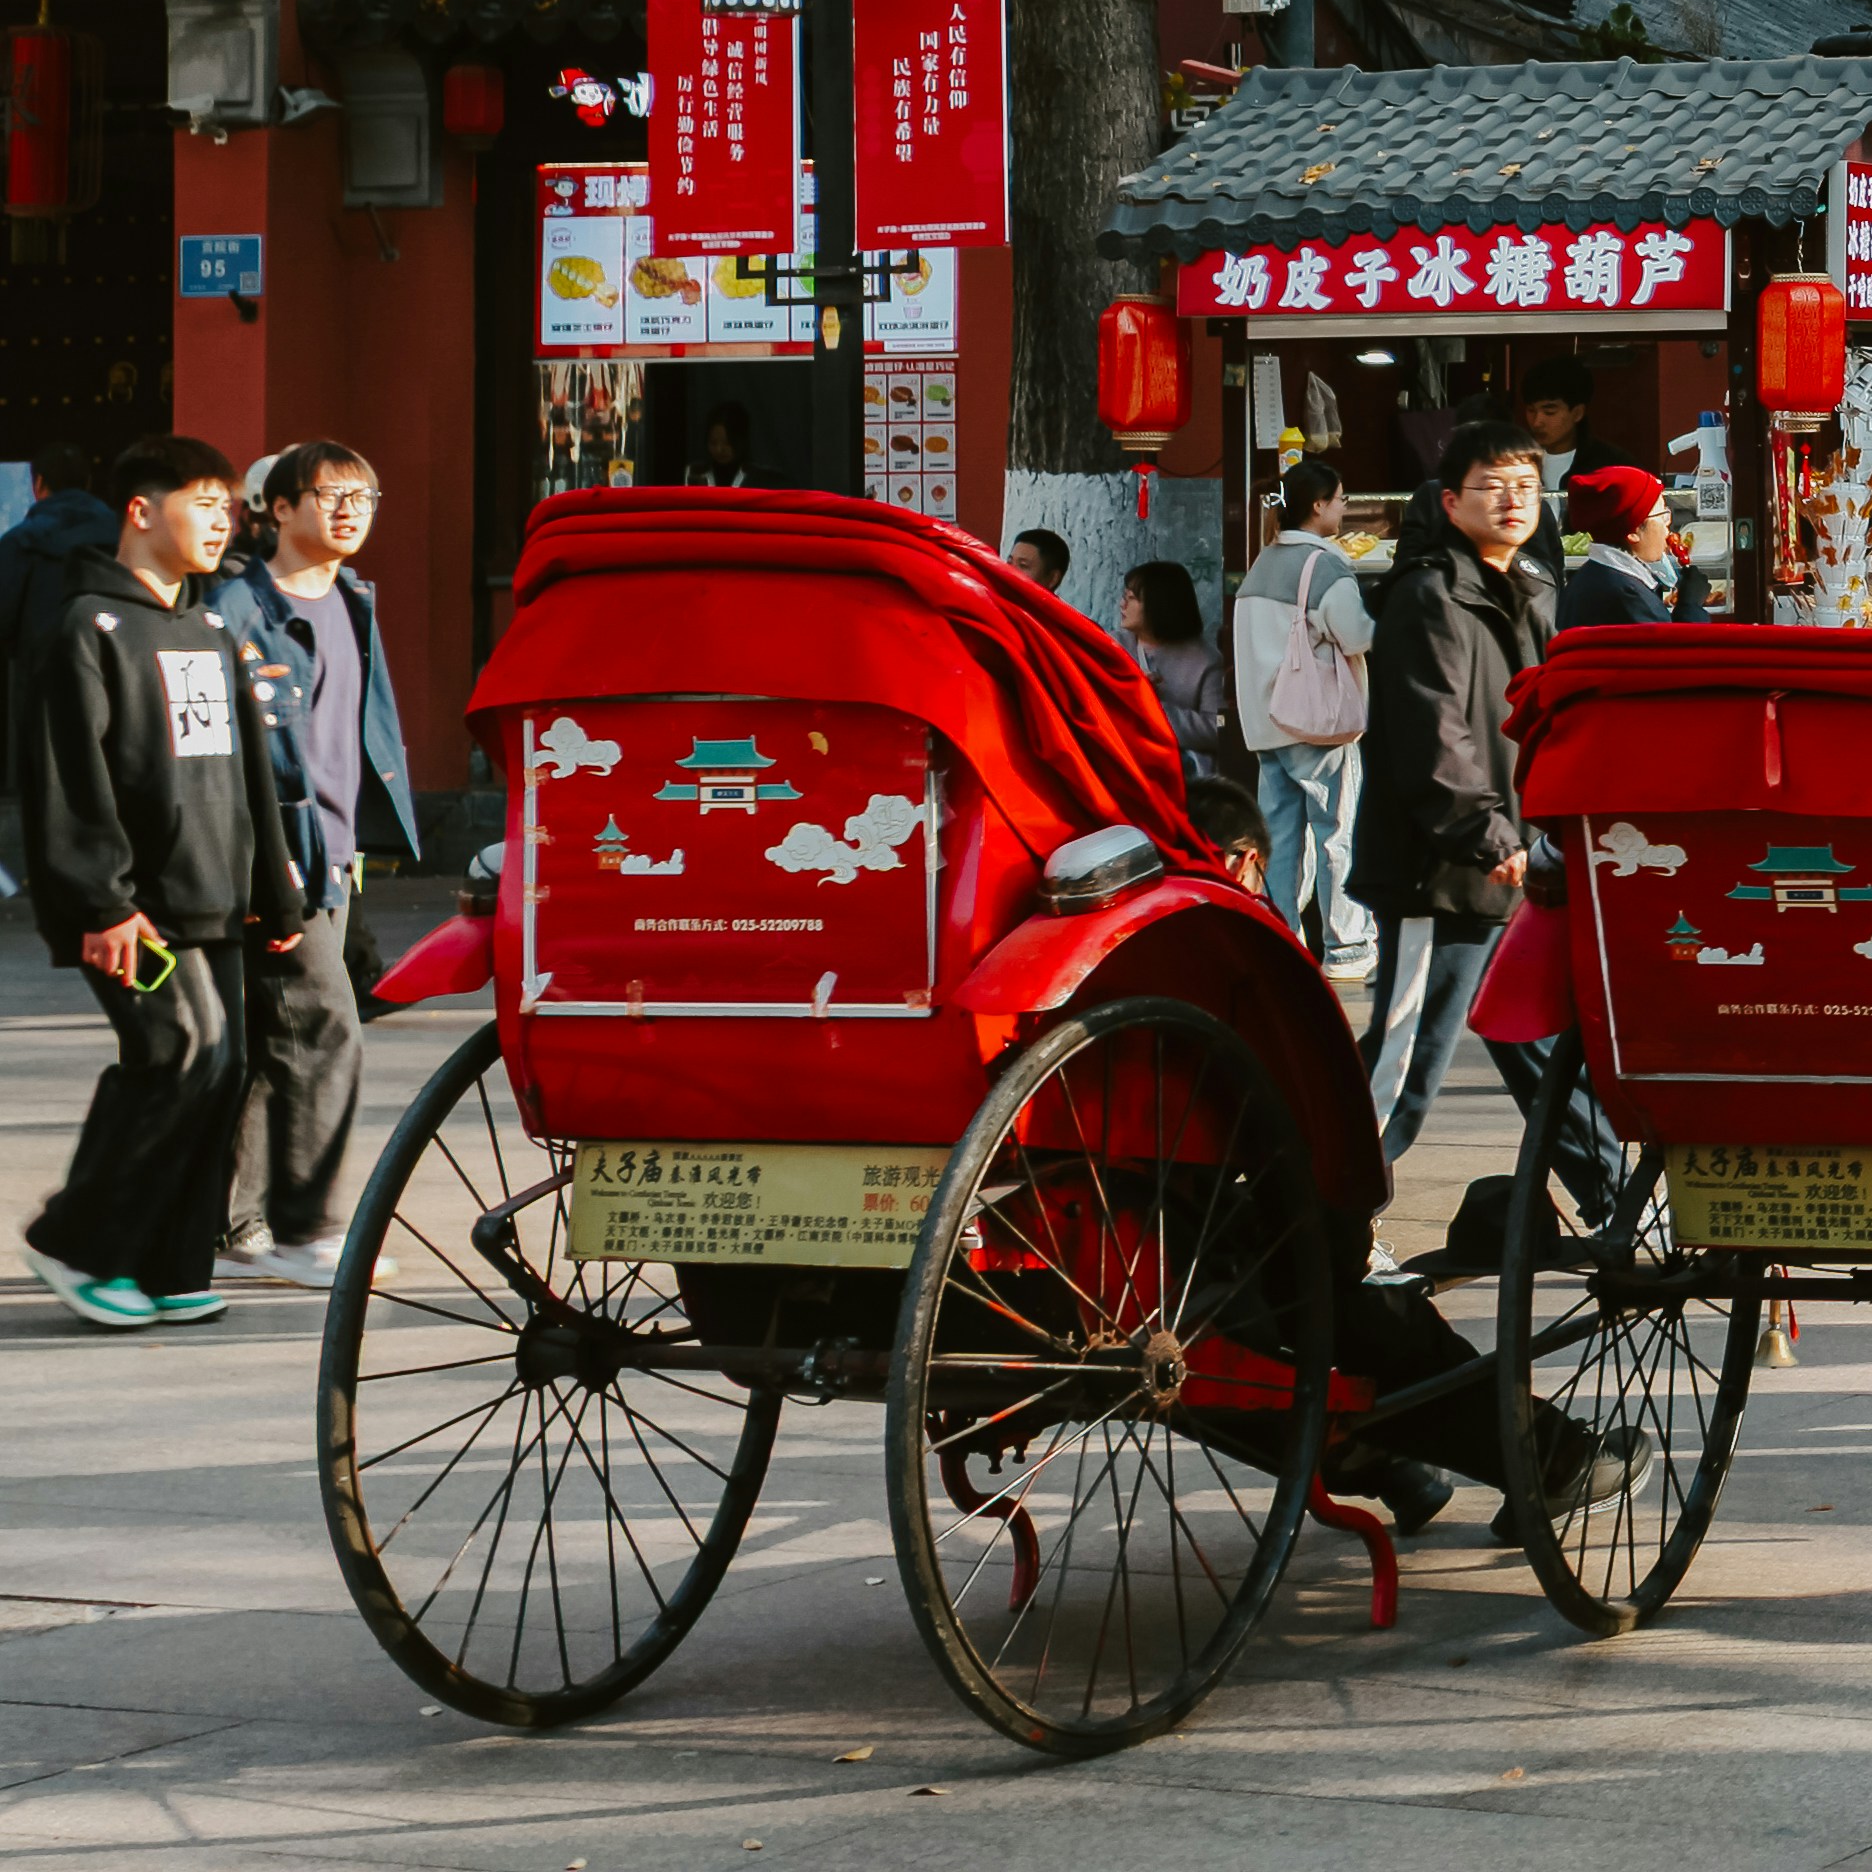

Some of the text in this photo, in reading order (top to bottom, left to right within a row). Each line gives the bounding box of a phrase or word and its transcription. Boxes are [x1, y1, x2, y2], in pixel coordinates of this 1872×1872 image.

[727, 40, 745, 163] 诚信经营服务
[919, 30, 941, 136] 国家有力量
[948, 2, 969, 110] 人民有信仰
[676, 74, 695, 196] 厉行勤俭节约
[892, 56, 913, 163] 民族有希望
[200, 259, 226, 278] 95
[1212, 230, 1694, 311] 奶皮子冰糖葫芦
[732, 918, 824, 932] 025-52209788
[589, 1149, 663, 1186] 夫子庙
[1682, 1145, 1759, 1179] 夫子庙
